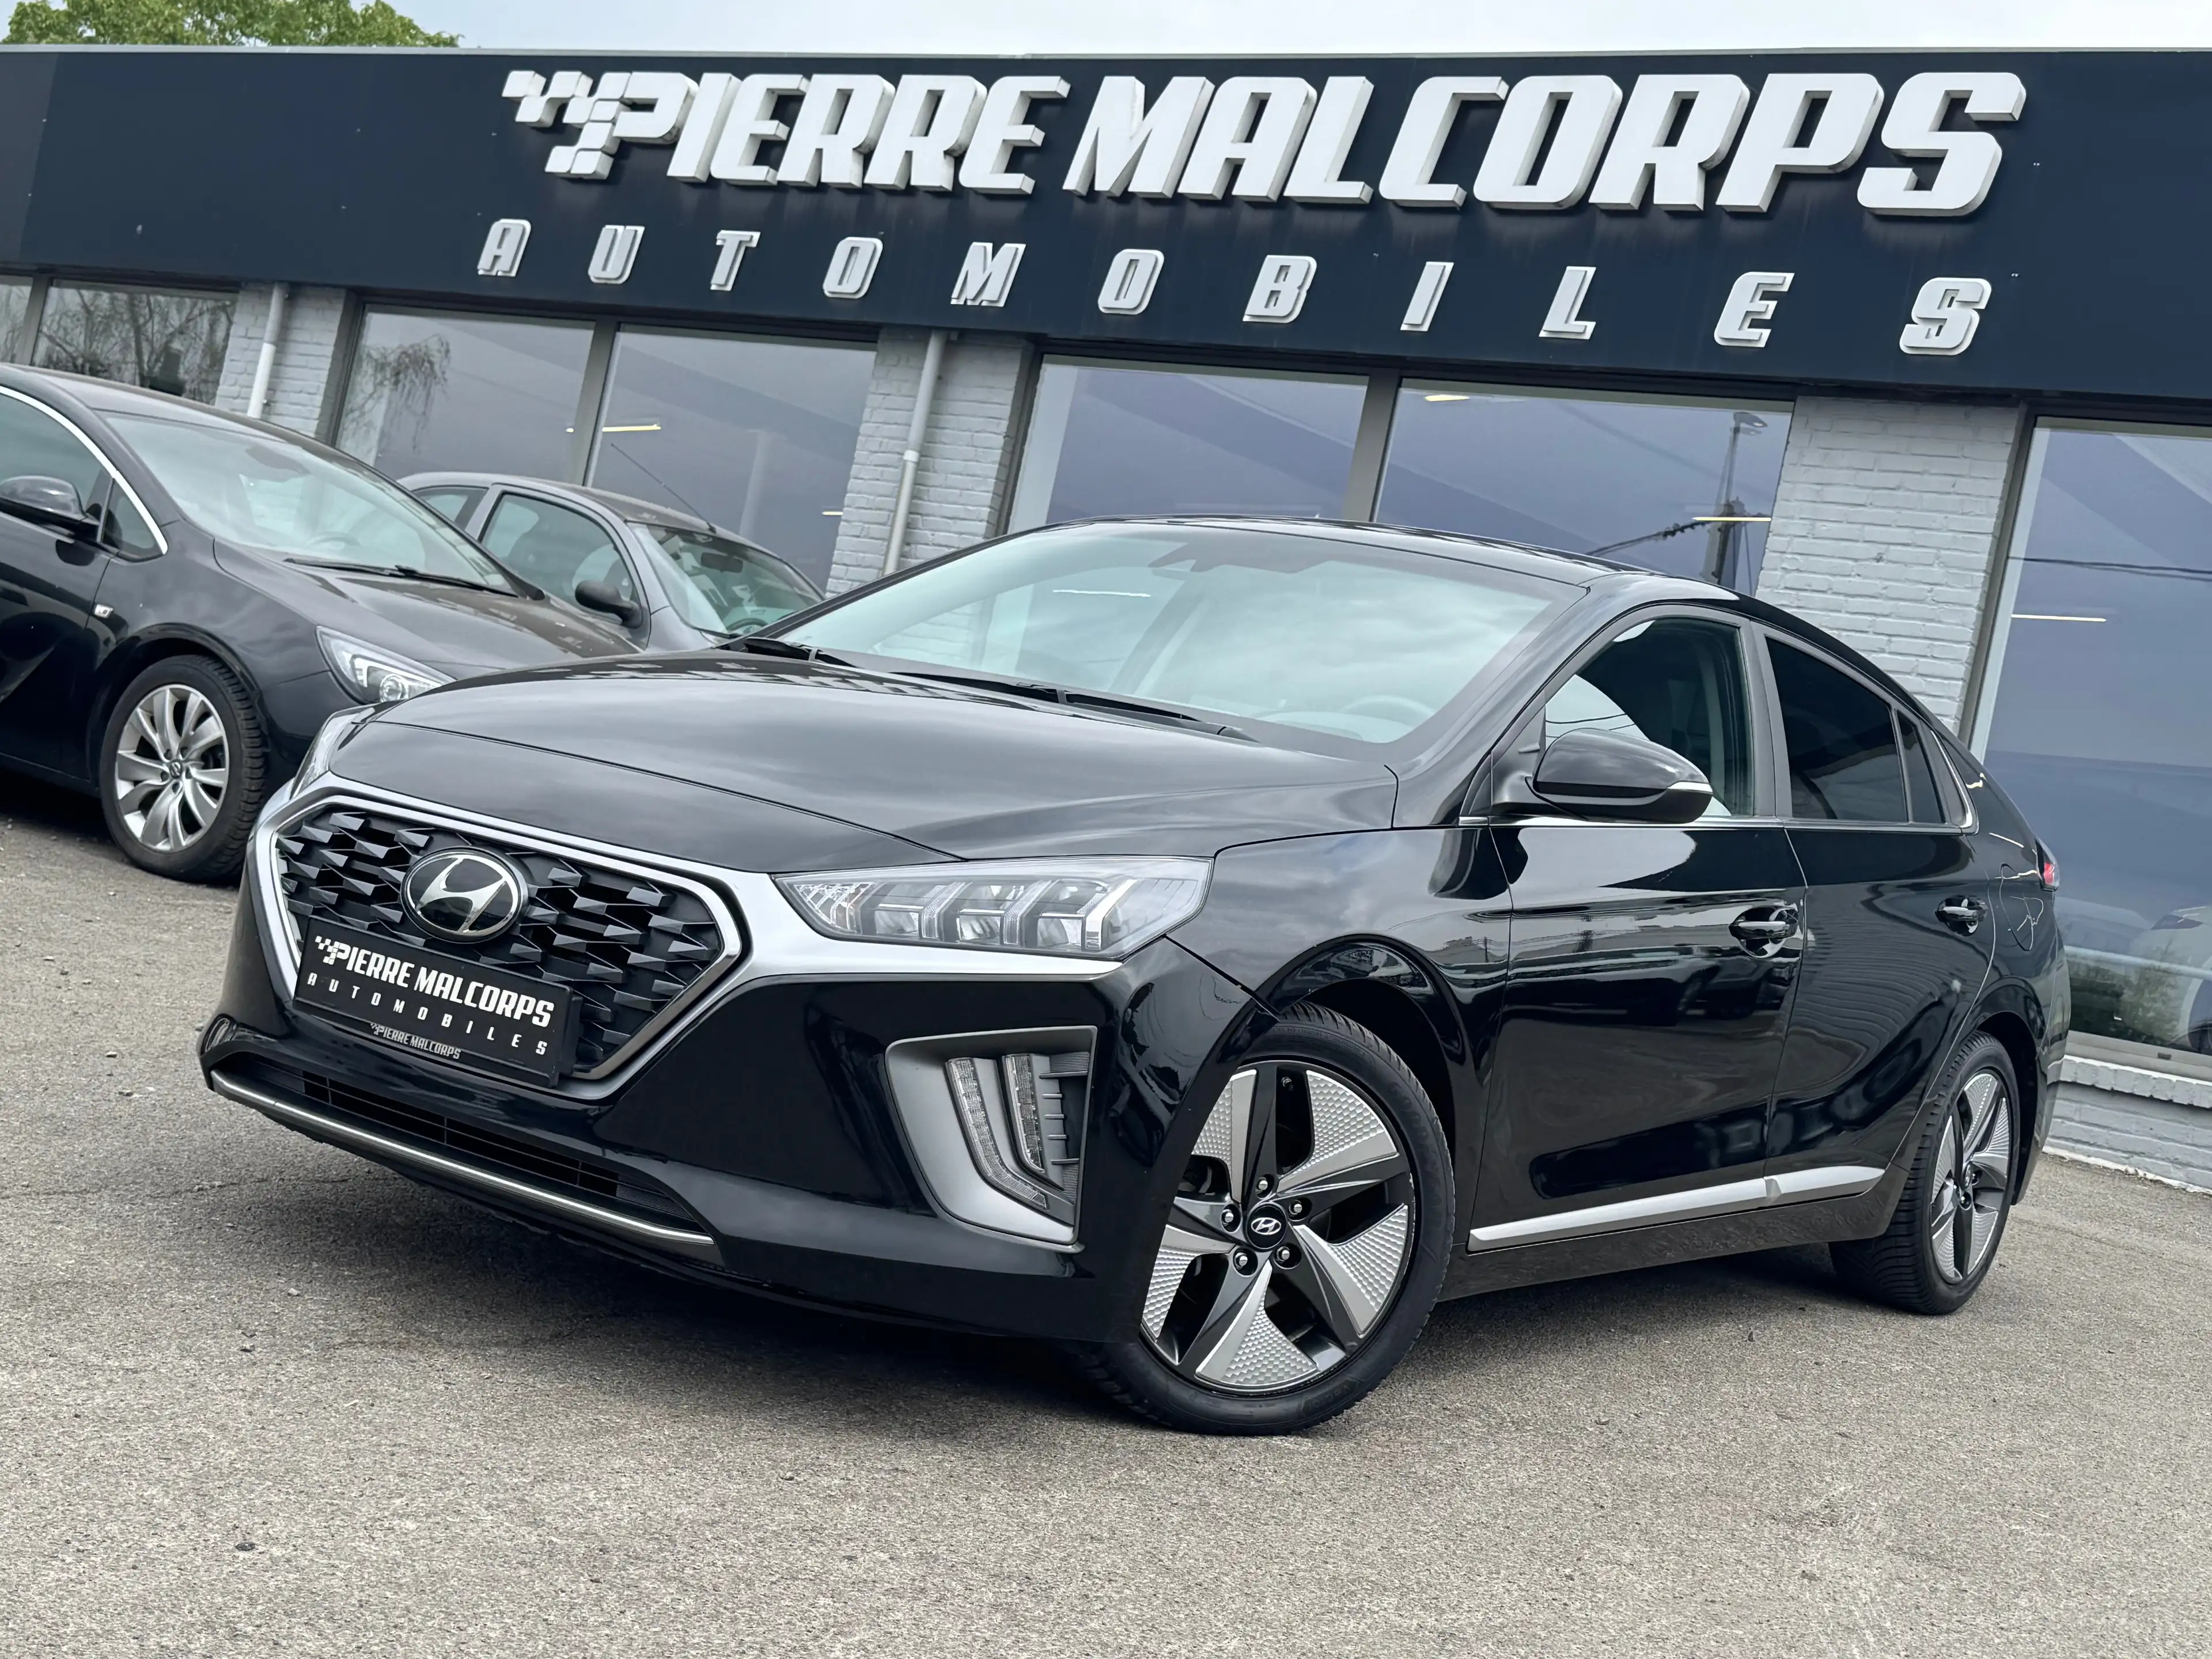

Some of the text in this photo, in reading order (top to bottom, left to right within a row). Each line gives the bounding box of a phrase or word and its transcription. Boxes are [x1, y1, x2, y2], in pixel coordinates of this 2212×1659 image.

[544, 71, 2027, 218] PIERRE MALCORPS
[477, 218, 1991, 356] AUTOMOBILES
[306, 972, 547, 1055] AUTOMOBILES
[323, 940, 554, 1028] PIERRE MALCORPS
[373, 1024, 461, 1059] PIERRE MALCORPS
